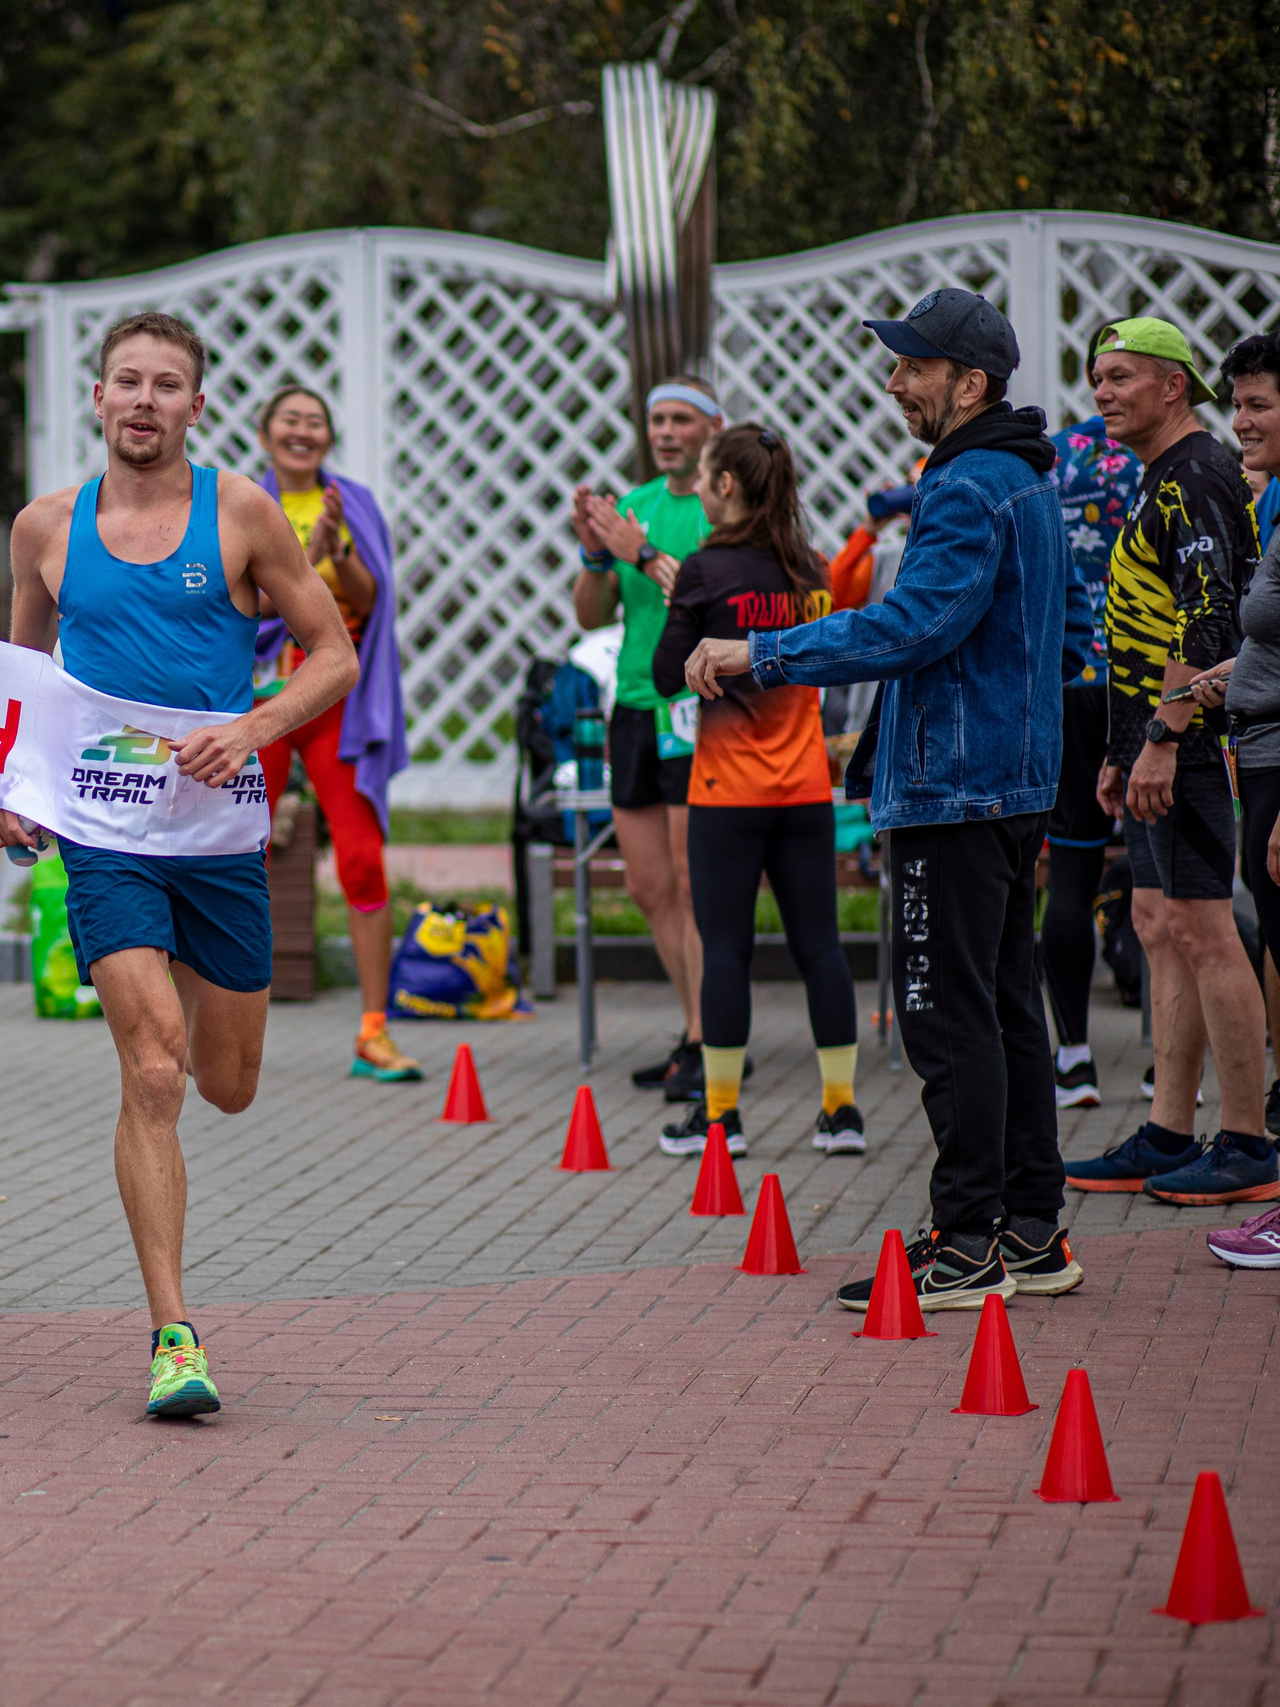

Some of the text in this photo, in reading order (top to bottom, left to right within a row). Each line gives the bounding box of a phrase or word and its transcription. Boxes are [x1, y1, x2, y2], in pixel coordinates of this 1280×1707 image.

[70, 767, 168, 790] DREAM
[76, 784, 154, 805] TRAIL
[903, 857, 934, 1012] PFC CSKA
